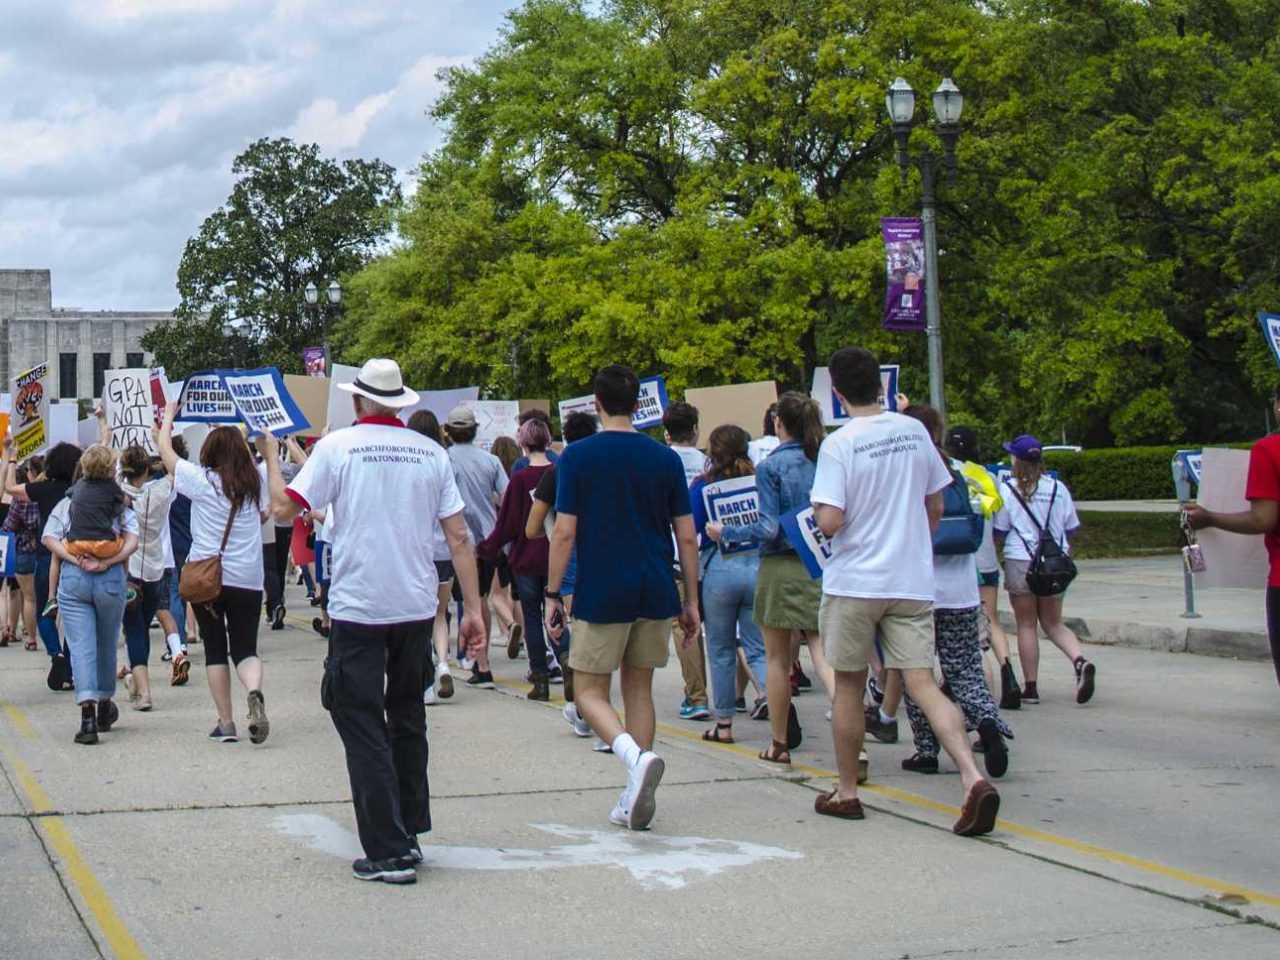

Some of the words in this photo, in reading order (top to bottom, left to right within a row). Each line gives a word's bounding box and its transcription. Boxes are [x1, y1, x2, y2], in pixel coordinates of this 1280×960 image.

[16, 364, 47, 388] CHANGE
[108, 376, 147, 407] GPA
[186, 391, 208, 401] FOR
[230, 382, 264, 397] MARCH
[186, 402, 217, 413] LIVES
[251, 396, 279, 413] OUR
[113, 404, 148, 427] NOT
[16, 433, 47, 460] REFORM
[112, 427, 154, 452] NRA
[362, 456, 422, 464] #BATONROUGE
[717, 498, 757, 516] MARCH
[741, 511, 759, 525] OU
